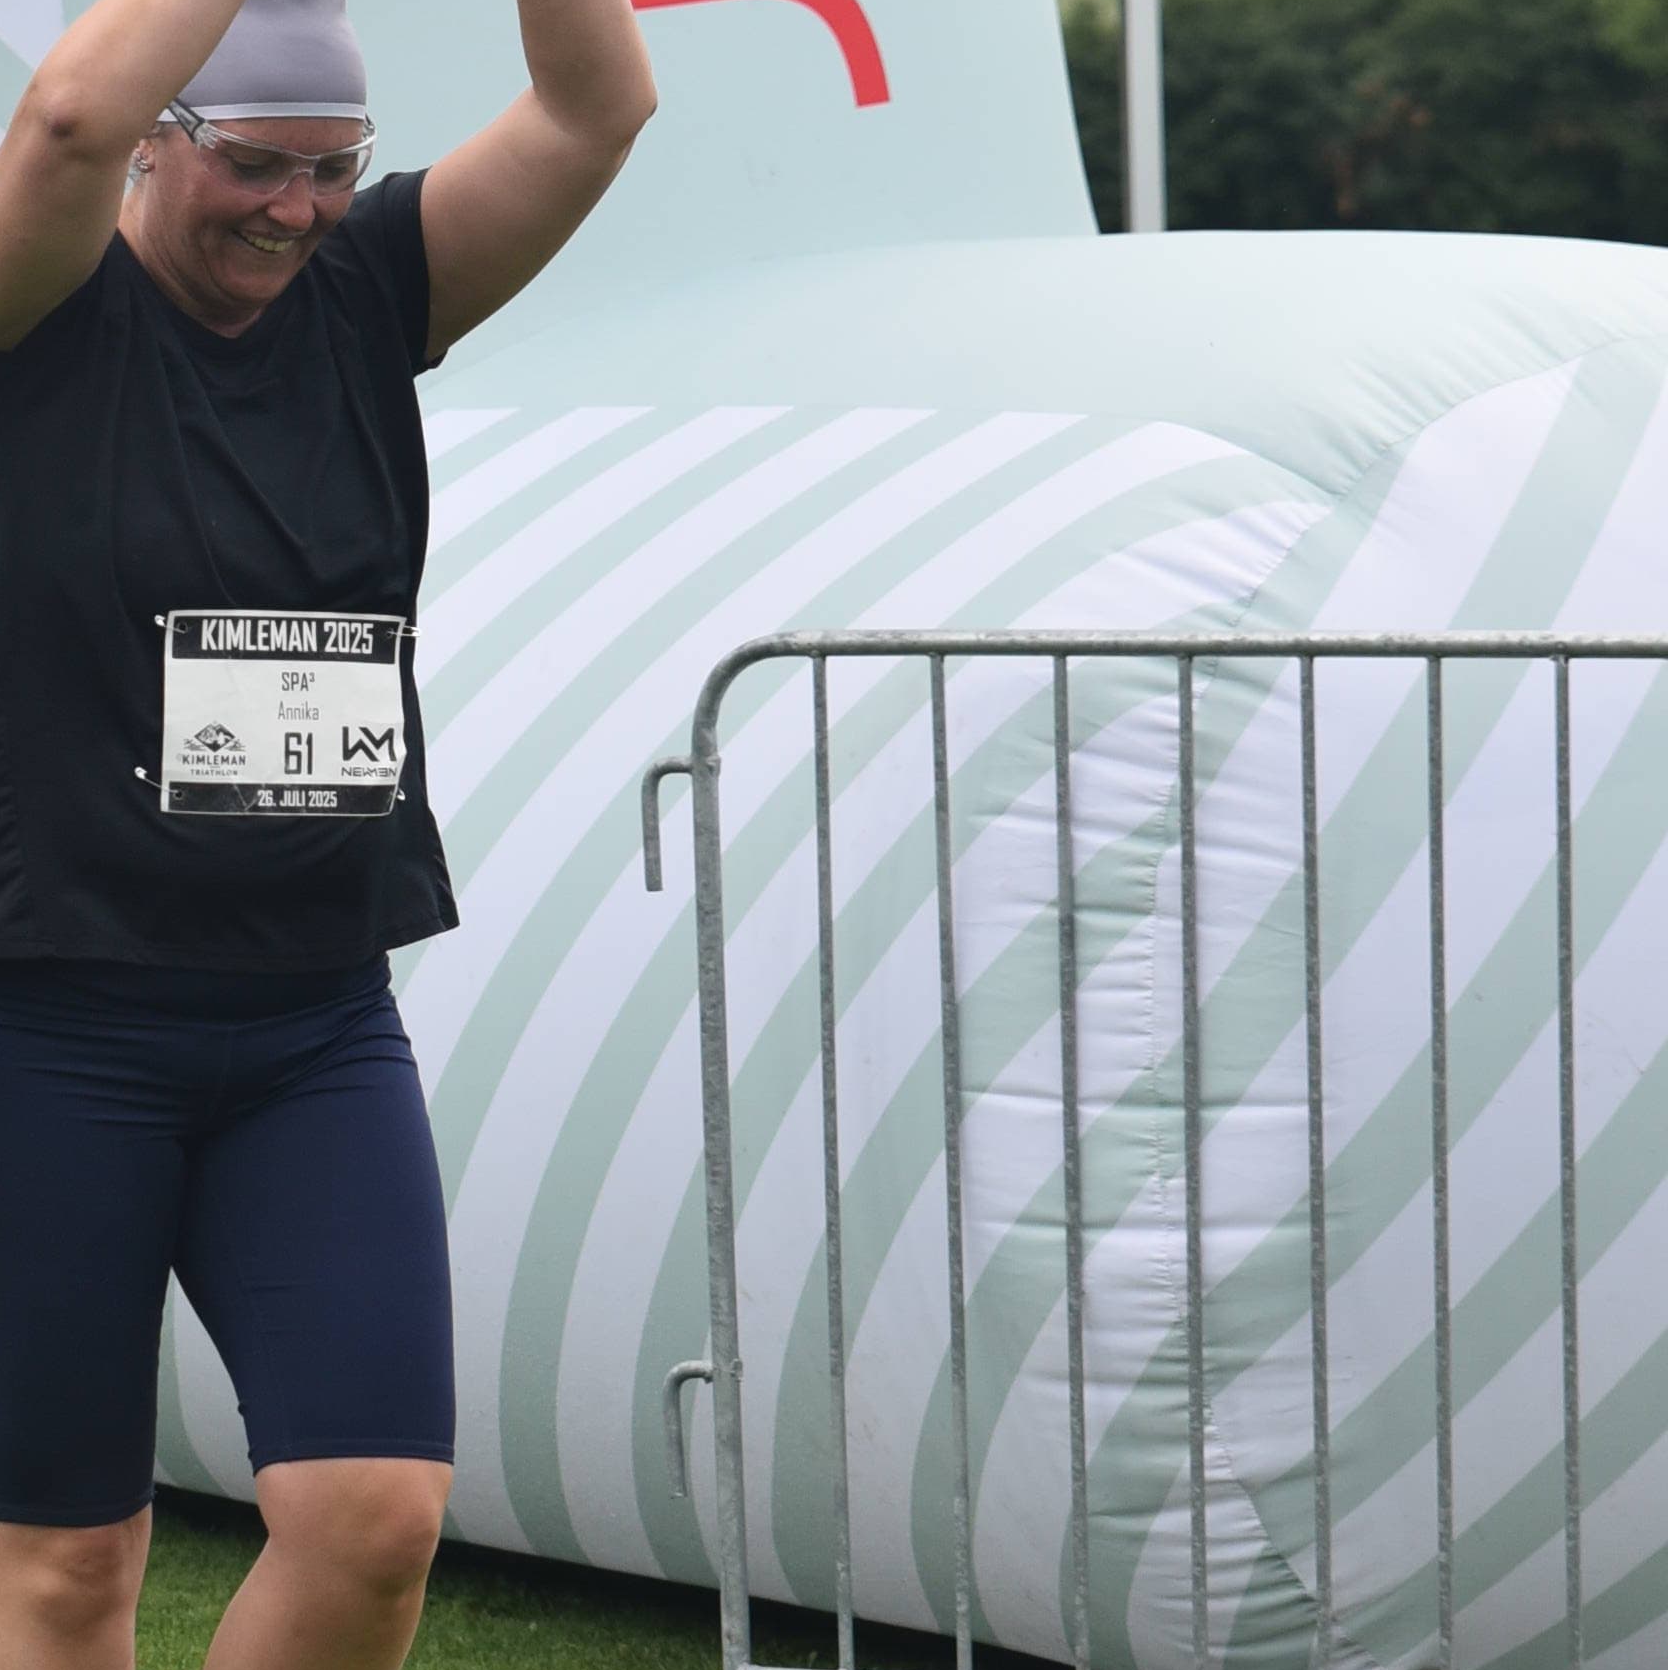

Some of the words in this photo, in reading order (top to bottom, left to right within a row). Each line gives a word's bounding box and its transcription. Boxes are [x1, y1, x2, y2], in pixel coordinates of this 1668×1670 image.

[201, 618, 318, 652] KIMLEMAN
[323, 621, 374, 654] 2025
[277, 700, 320, 721] Annika
[181, 754, 246, 766] KIMLEMAN
[284, 732, 313, 775] 61
[257, 789, 277, 807] 26.
[279, 790, 306, 807] JULI
[308, 790, 338, 808] 2025
